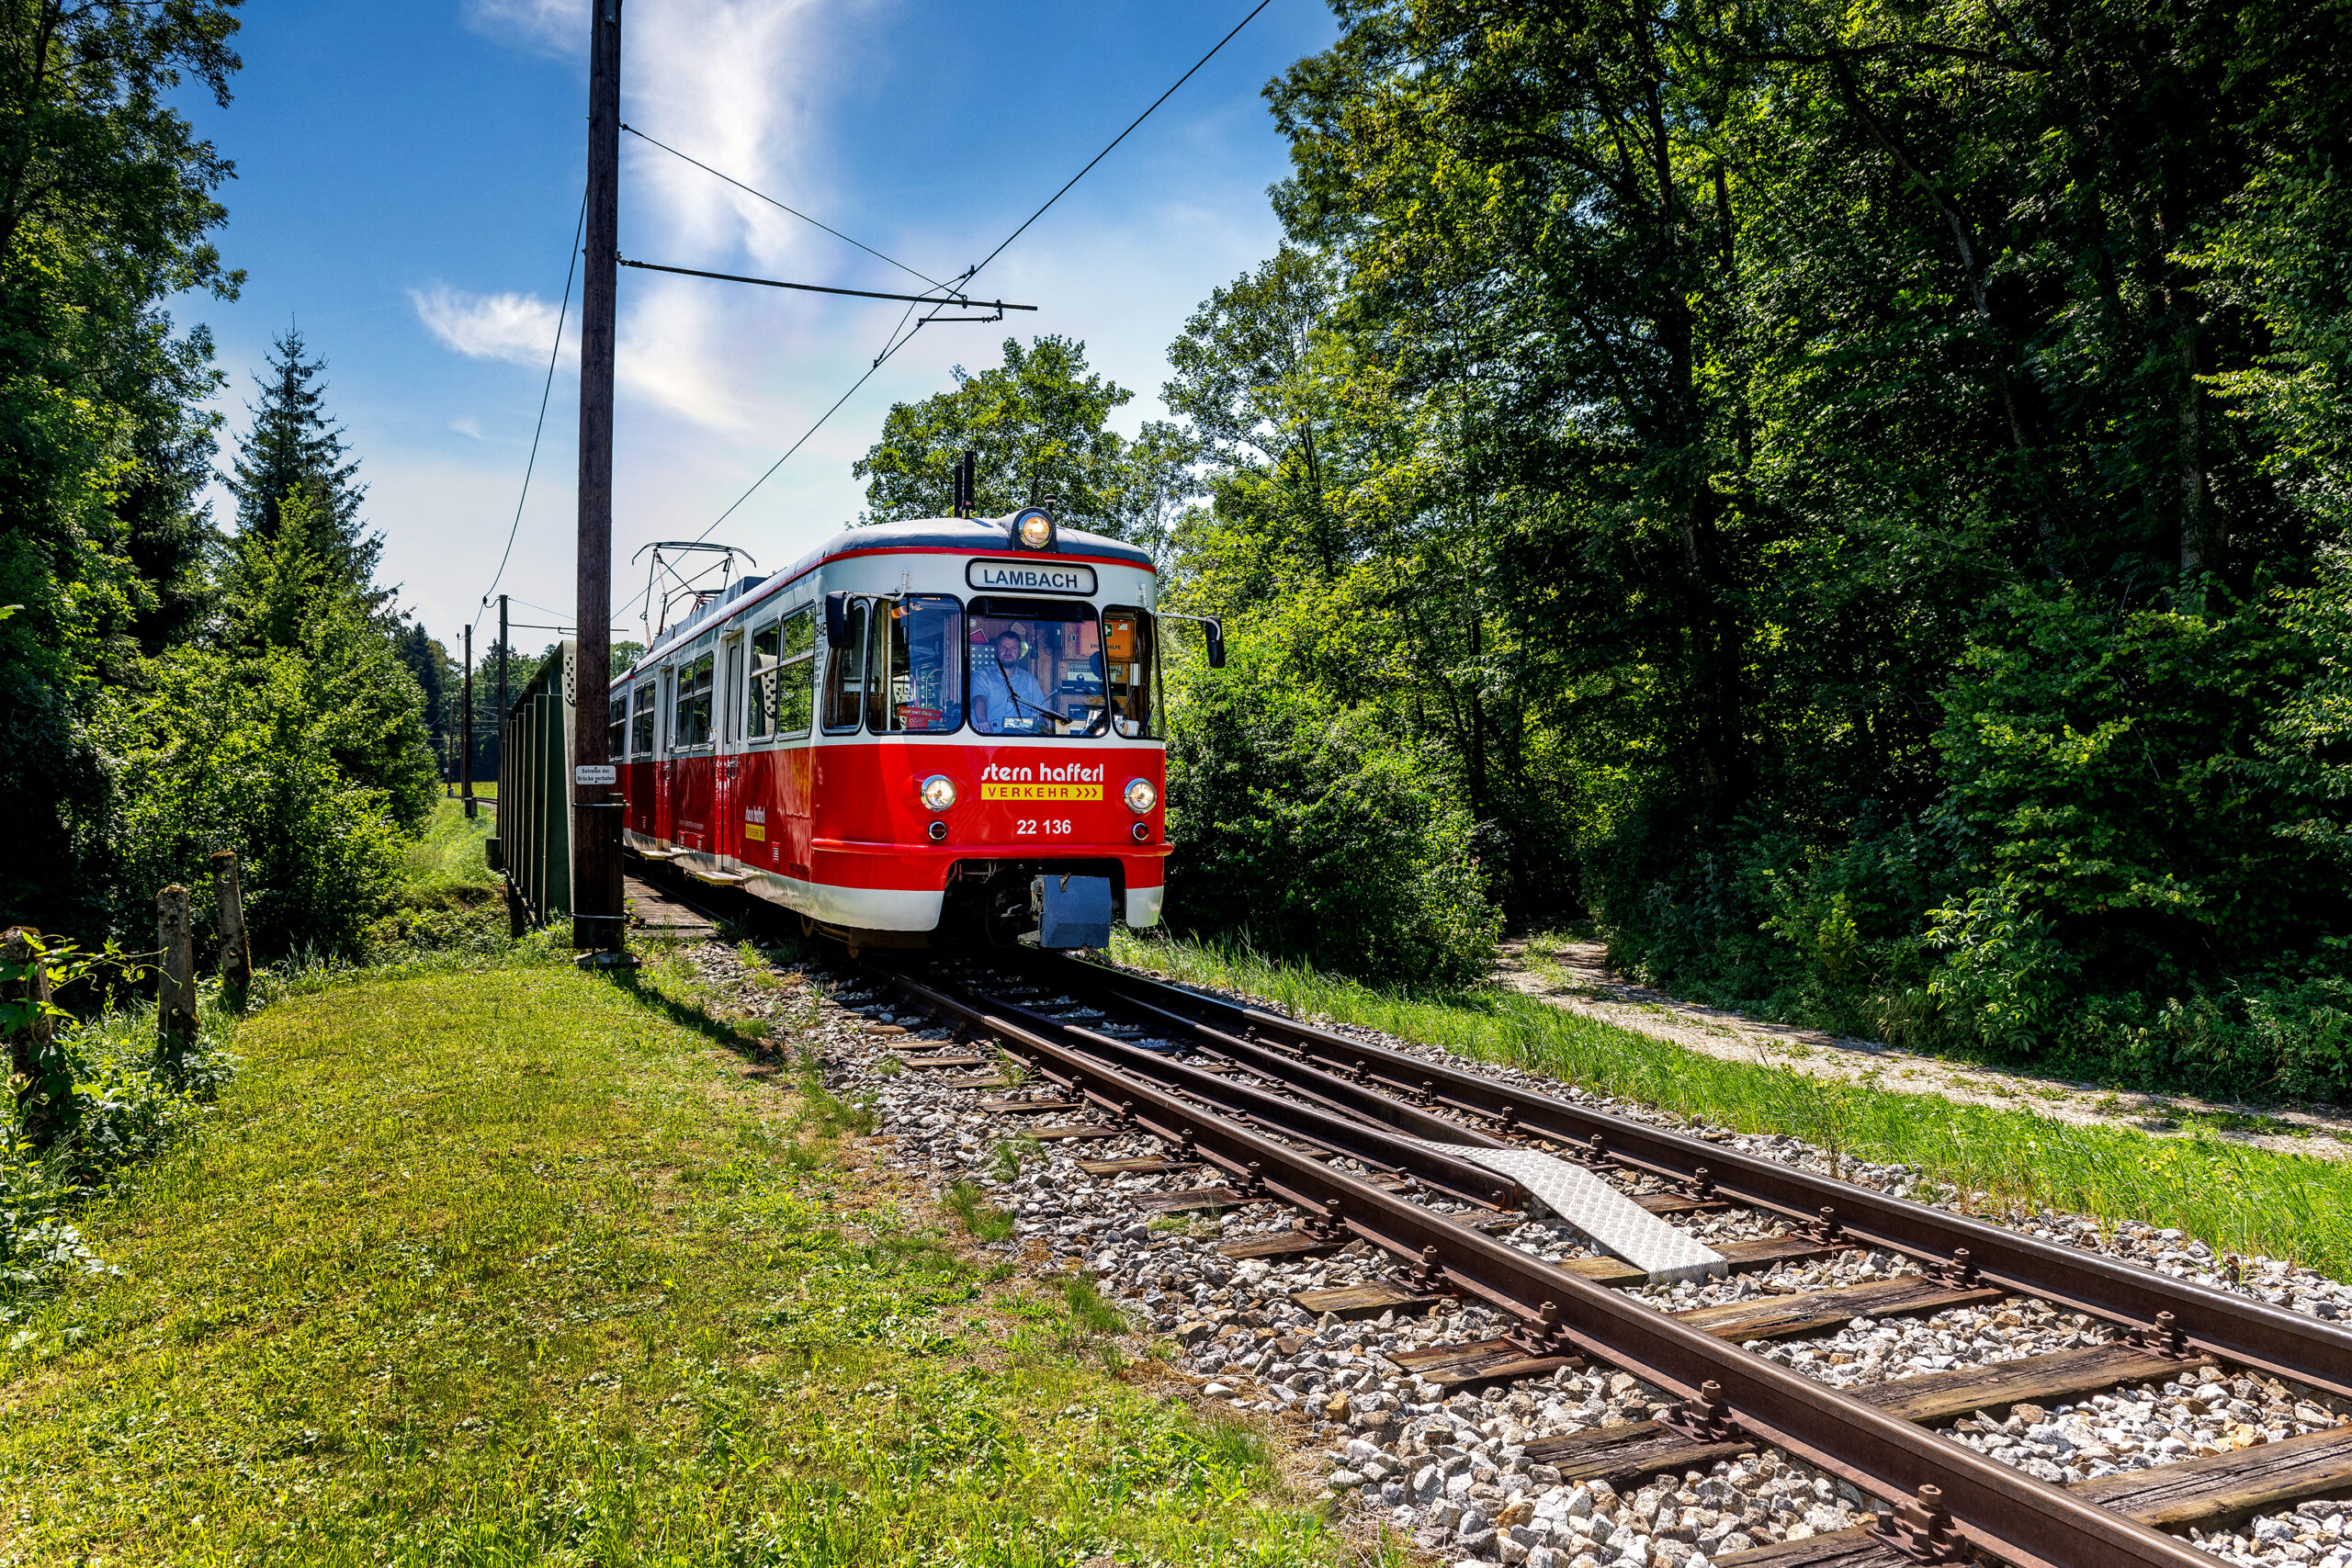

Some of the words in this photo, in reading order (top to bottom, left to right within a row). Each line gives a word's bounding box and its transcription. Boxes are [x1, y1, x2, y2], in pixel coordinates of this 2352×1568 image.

[984, 569, 1078, 589] LAMBACH
[981, 762, 1033, 781] stern
[1039, 762, 1104, 782] hafferl
[988, 786, 1069, 798] VERKEHR
[1016, 819, 1037, 835] 22
[1042, 819, 1072, 835] 136
